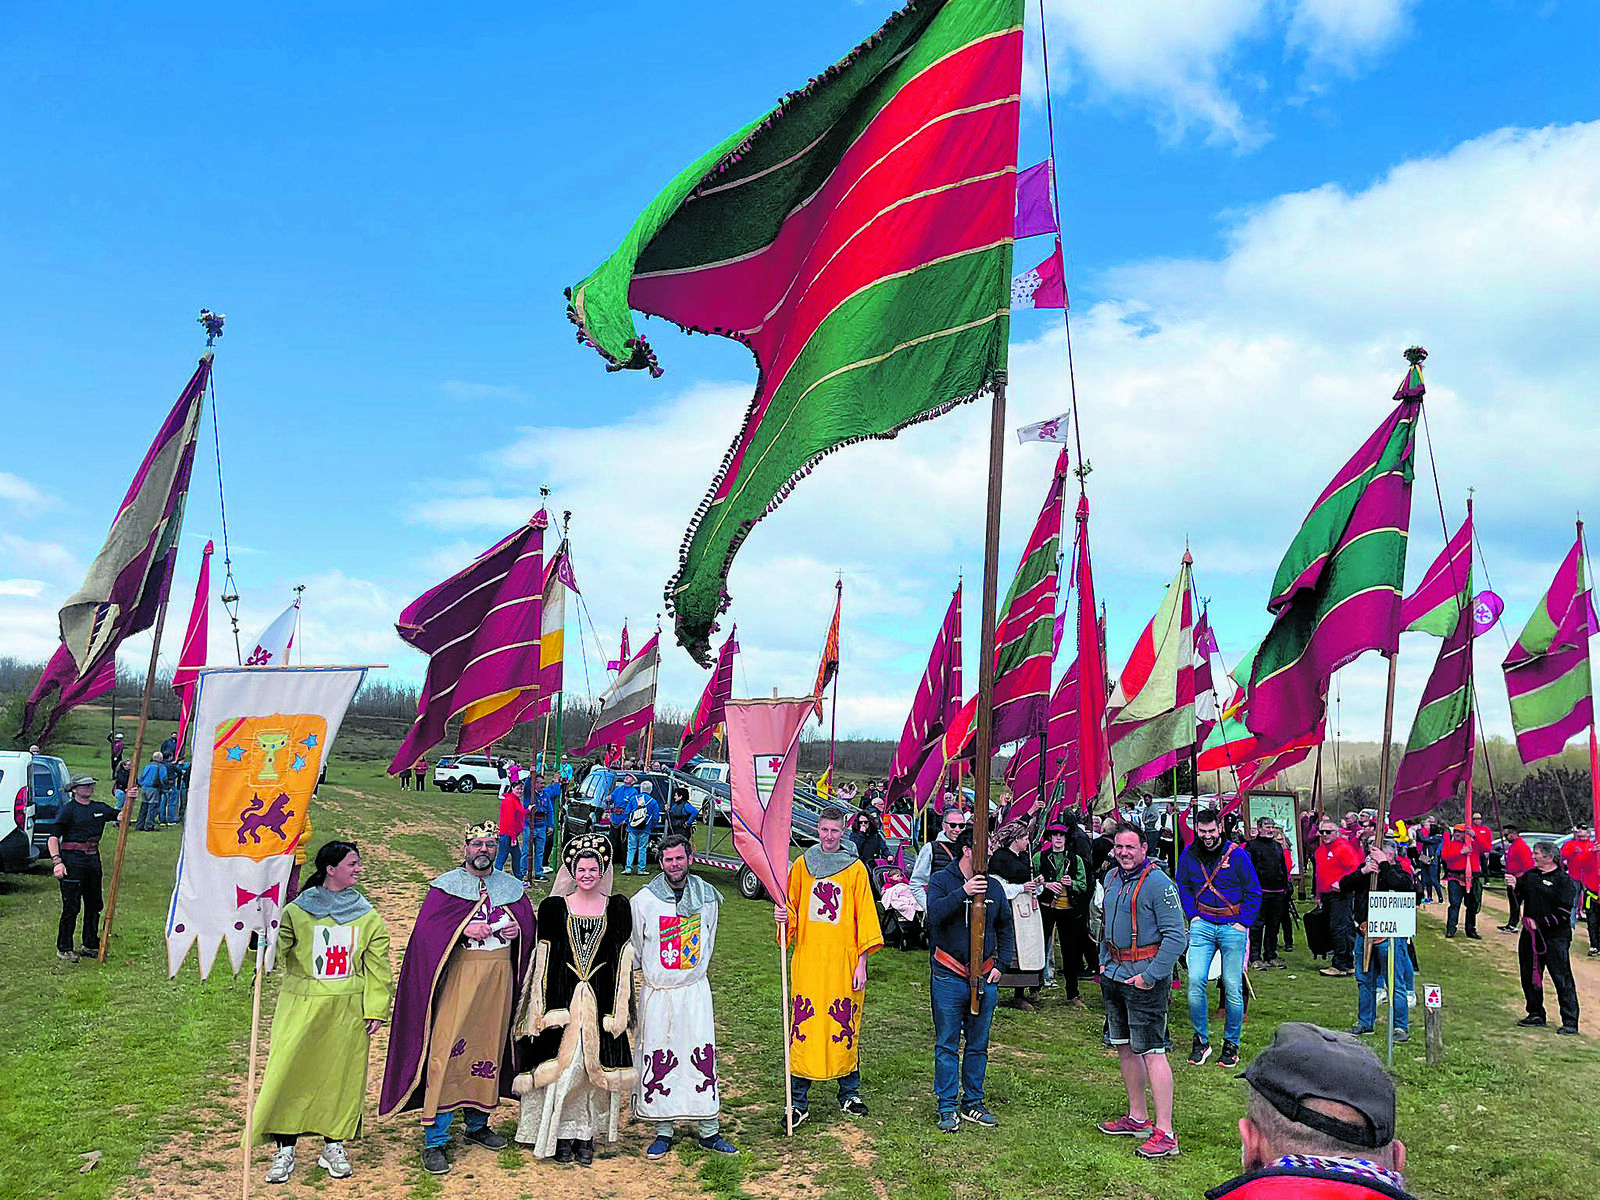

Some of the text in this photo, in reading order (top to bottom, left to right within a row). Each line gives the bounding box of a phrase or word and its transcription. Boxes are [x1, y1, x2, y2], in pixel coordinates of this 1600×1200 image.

[1369, 896, 1415, 909] COTO PRIVADO
[1368, 921, 1398, 933] DE CAZA
